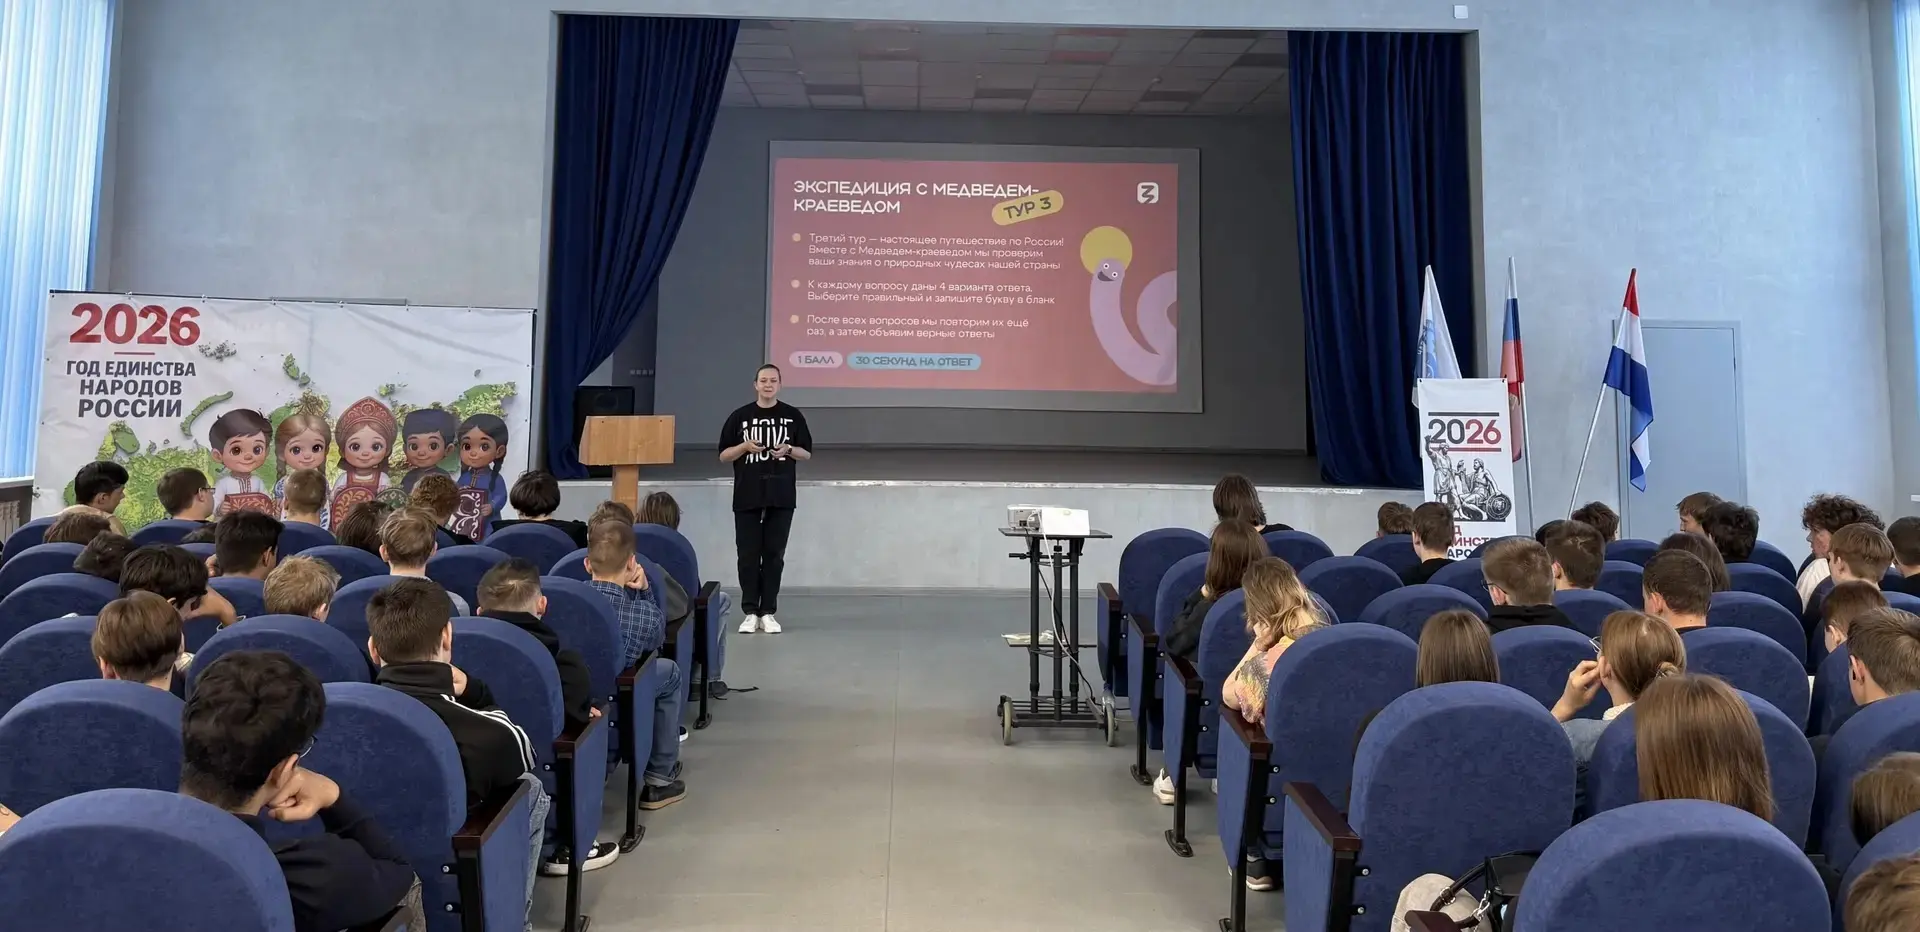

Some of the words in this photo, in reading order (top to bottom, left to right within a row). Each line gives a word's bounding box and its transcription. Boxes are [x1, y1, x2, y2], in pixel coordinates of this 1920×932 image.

[794, 180, 911, 196] ЭКСПЕДИЦИЯ
[916, 183, 928, 195] С
[933, 183, 1040, 198] МЕДВЕДЕМ-
[794, 199, 900, 214] КРАЕВЕДОМ
[1003, 201, 1035, 219] ТУР
[1039, 197, 1052, 210] 3
[809, 233, 846, 244] Третий
[849, 236, 866, 245] тур
[880, 236, 936, 245] настоящее
[940, 237, 1007, 247] путешествие
[1009, 238, 1022, 246] по
[1025, 237, 1064, 247] России!
[808, 245, 847, 255] Вместе
[849, 247, 856, 255] с
[858, 246, 972, 258] Медведем-краеведом
[992, 250, 1044, 260] проверим
[808, 258, 835, 266] ваши
[837, 258, 872, 266] знания
[874, 259, 882, 267] о
[884, 260, 941, 269] природных
[944, 260, 985, 269] чудесах
[988, 260, 1021, 269] нашей
[1023, 262, 1061, 271] страны
[808, 280, 815, 289] К
[817, 281, 862, 291] каждому
[865, 282, 909, 291] вопросу
[911, 283, 937, 292] даны
[939, 282, 946, 291] 4
[948, 284, 994, 292] варианта
[807, 291, 860, 302] Выберите
[862, 292, 924, 302] правильный
[935, 295, 983, 304] запишите
[985, 294, 1014, 305] букву
[1017, 296, 1024, 304] в
[1025, 295, 1055, 304] бланк
[69, 302, 200, 346] 2026
[807, 314, 840, 325] После
[842, 317, 867, 325] всех
[869, 317, 920, 326] вопросов
[922, 318, 937, 326] мы
[940, 318, 990, 328] повторим
[992, 319, 1004, 327] их
[1006, 318, 1029, 328] ещё
[806, 328, 826, 338] раз,
[869, 328, 914, 337] объявим
[917, 330, 956, 339] верные
[958, 330, 995, 338] ответы
[798, 356, 802, 364] 1
[804, 355, 835, 364] БАЛЛ
[856, 356, 870, 365] 30
[872, 356, 917, 366] СЕКУНД
[920, 357, 935, 366] НА
[937, 357, 973, 367] ОТВЕТ
[66, 360, 101, 378] ГОД
[105, 361, 197, 378] ЕДИНСТВА
[79, 379, 182, 397] НАРОДОВ
[78, 398, 182, 418] РОССИИ
[1428, 418, 1502, 445] 2026
